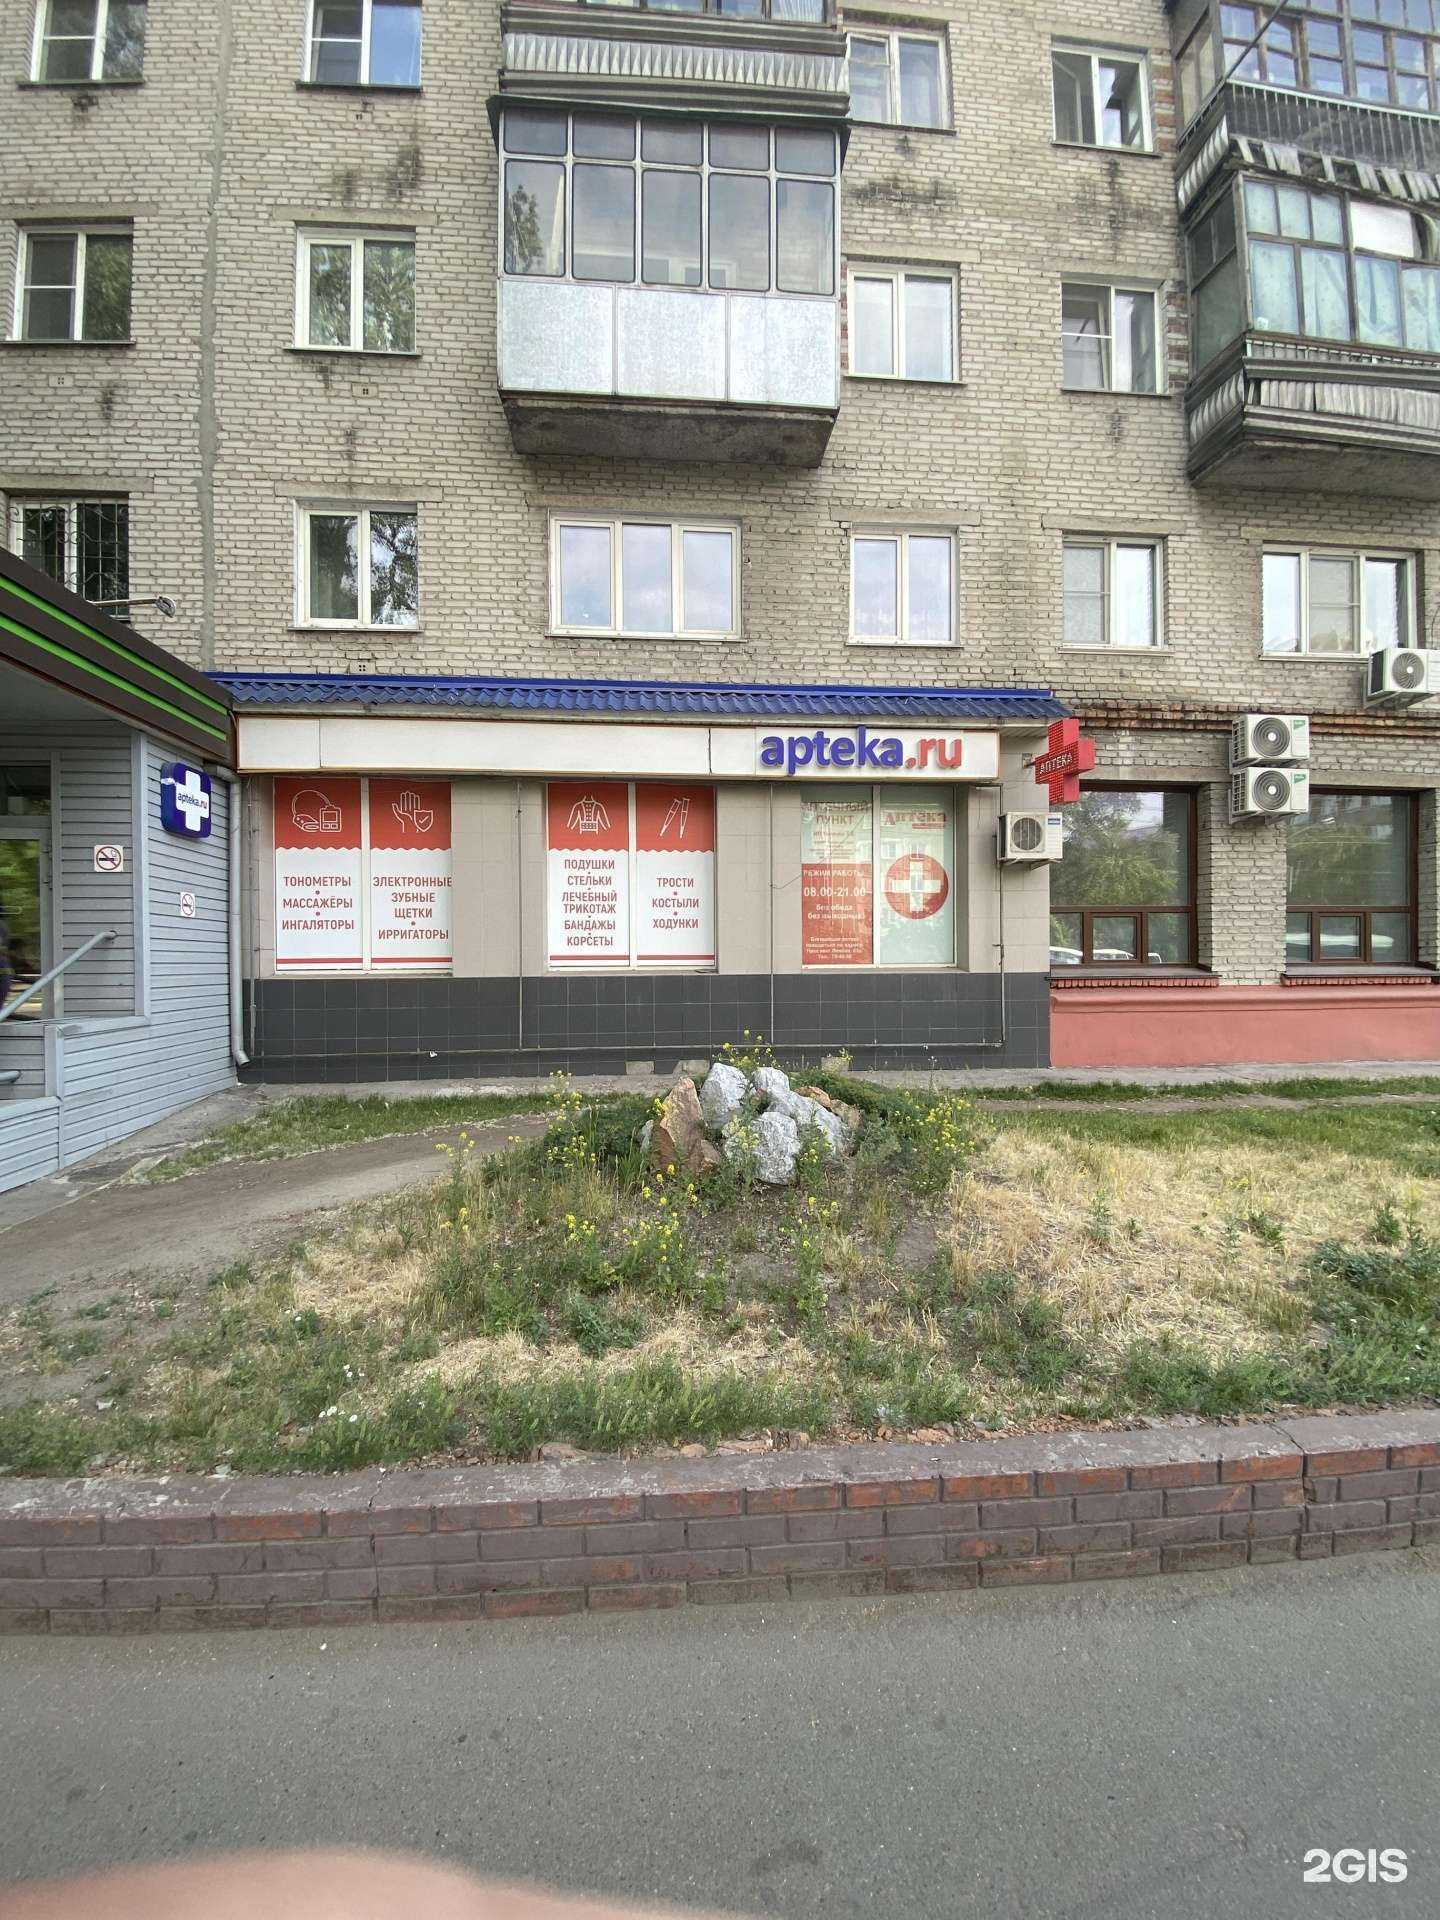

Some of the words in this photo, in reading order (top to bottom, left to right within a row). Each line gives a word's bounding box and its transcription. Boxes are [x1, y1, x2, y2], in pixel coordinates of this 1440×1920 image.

[760, 725, 964, 776] apteka.ru
[1039, 752, 1073, 775] АПТЕКА
[177, 793, 208, 809] apteka.ru
[816, 814, 854, 825] ПУНКТ
[564, 859, 615, 871] ПОДУШКИ
[283, 876, 352, 888] ТОНОМЕТРЫ
[373, 876, 452, 888] ЭЛЕКТРОННЫЕ
[567, 875, 612, 886] СТЕЛЬКИ
[656, 877, 694, 888] ТРОСТИ
[391, 892, 436, 903] ЗУБНЫЕ
[562, 890, 617, 902] ЛЕЧЕБНЫЙ
[803, 886, 867, 897] 08.00-21.00
[563, 903, 617, 914] ТРИКОТАЖ
[652, 897, 700, 909] КОСТЫЛИ
[394, 907, 433, 919] ЩЕТКИ
[282, 919, 355, 931] ИНГАЛЯТОРЫ
[564, 919, 616, 931] БАНДАЖЫ
[652, 918, 699, 929] ХОДУНКИ
[378, 929, 449, 940] ИРРИГАТОРЫ
[566, 936, 613, 946] КОРСЕТЫ
